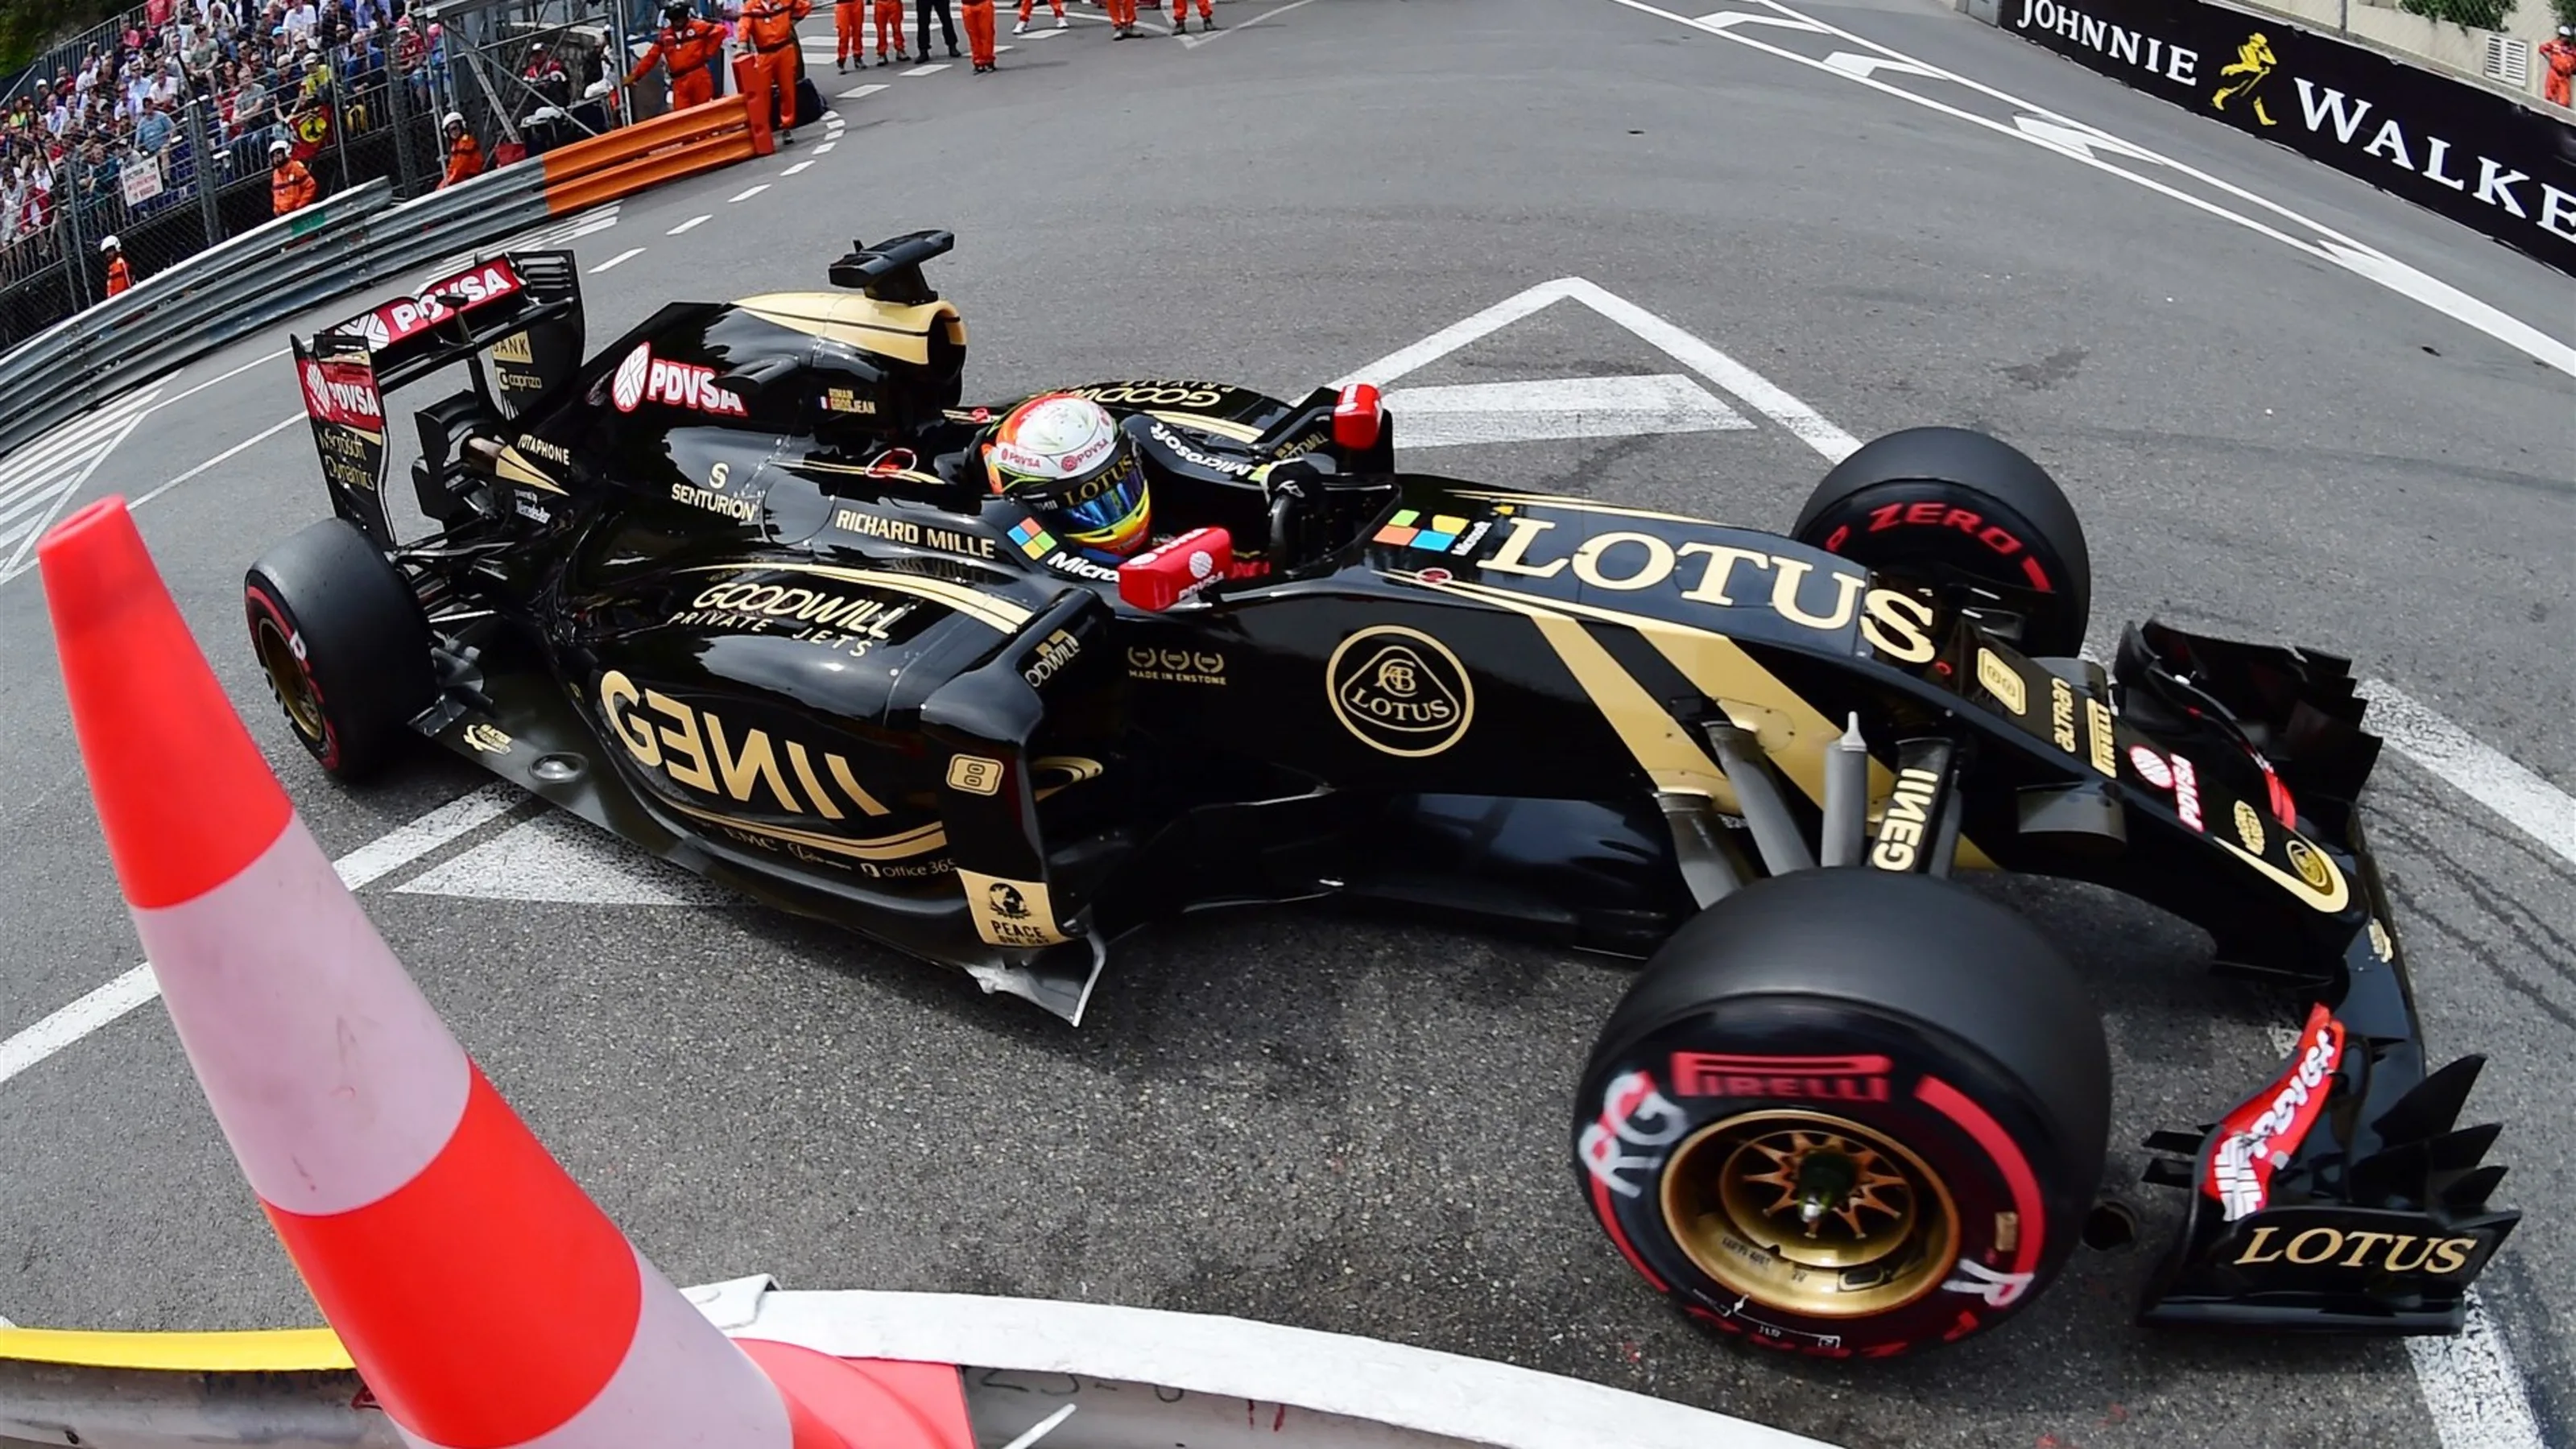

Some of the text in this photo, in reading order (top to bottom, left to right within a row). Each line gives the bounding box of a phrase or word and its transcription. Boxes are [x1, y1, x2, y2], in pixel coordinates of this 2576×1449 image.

[2016, 0, 2576, 244] JOHNNIE WALKE
[647, 361, 746, 413] PDVSA
[1149, 423, 1254, 480] Microsoft
[671, 482, 756, 522] SENTURION
[1064, 454, 1134, 507] LOTUS
[835, 509, 995, 559] RICHARD MILLE
[1868, 502, 2023, 554] ZERO
[693, 582, 905, 639] GOODWILL
[1477, 516, 1936, 664] LOTUS
[667, 611, 873, 658] PRIVATE JETS
[1128, 669, 1159, 679] MADE
[1350, 687, 1450, 722] LOTUS
[2086, 697, 2118, 779] PIRELLI
[2169, 753, 2205, 832] PDVSA
[882, 864, 927, 877] Office
[990, 919, 1044, 939] PEACE
[1670, 1051, 1894, 1101] PIRELLI
[1579, 1071, 1689, 1199] RG
[2233, 1227, 2478, 1274] LOTUS
